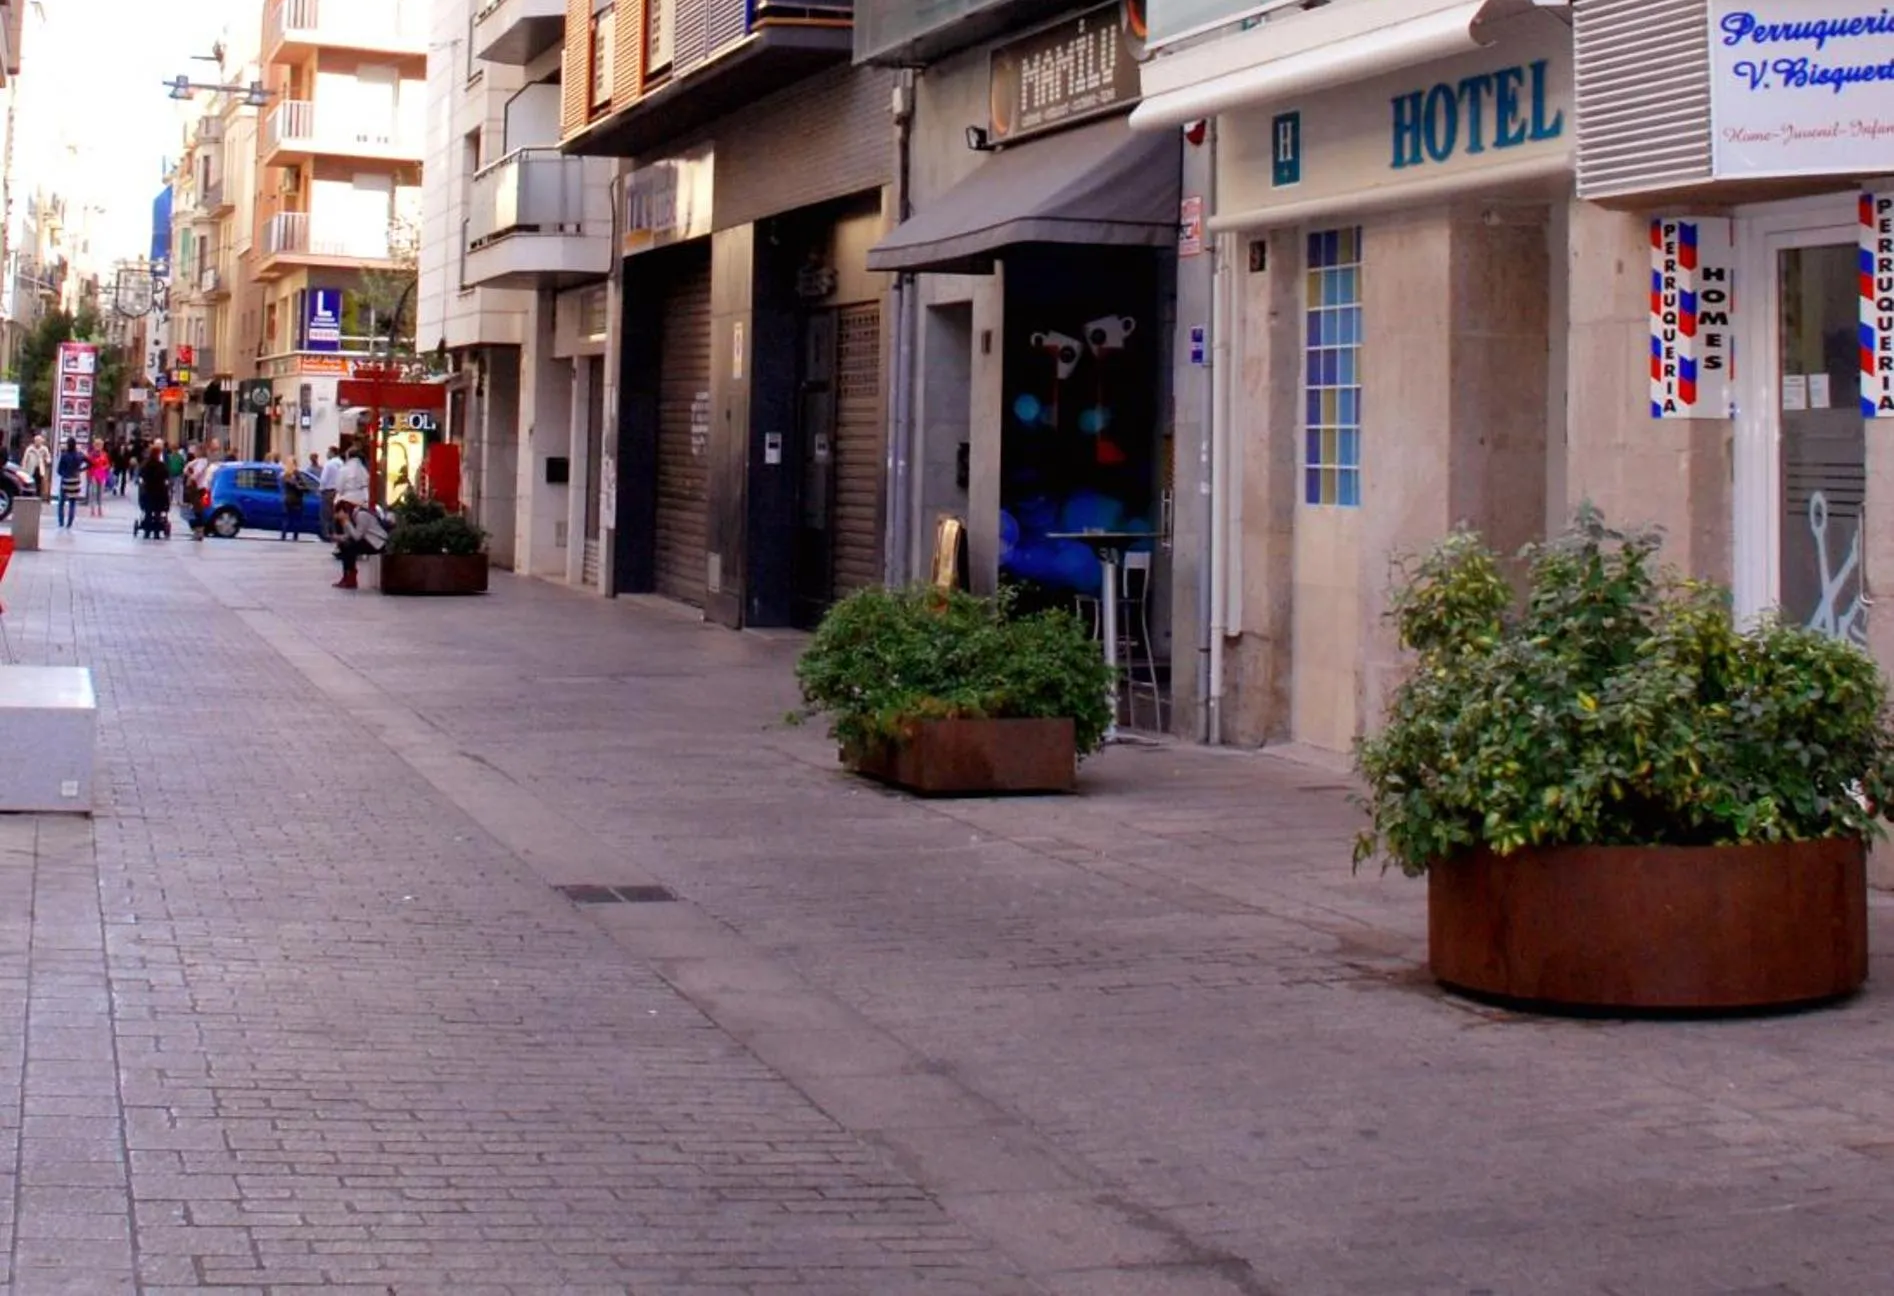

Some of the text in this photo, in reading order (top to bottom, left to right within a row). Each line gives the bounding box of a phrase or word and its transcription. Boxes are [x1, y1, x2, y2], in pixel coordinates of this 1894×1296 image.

[1278, 121, 1293, 162] H
[1390, 58, 1563, 169] HOTEL
[317, 290, 333, 317] L
[1662, 224, 1676, 412] PERRUQUERIA
[1699, 267, 1728, 369] HOMES
[1876, 199, 1894, 410] PERRUQUERIA
